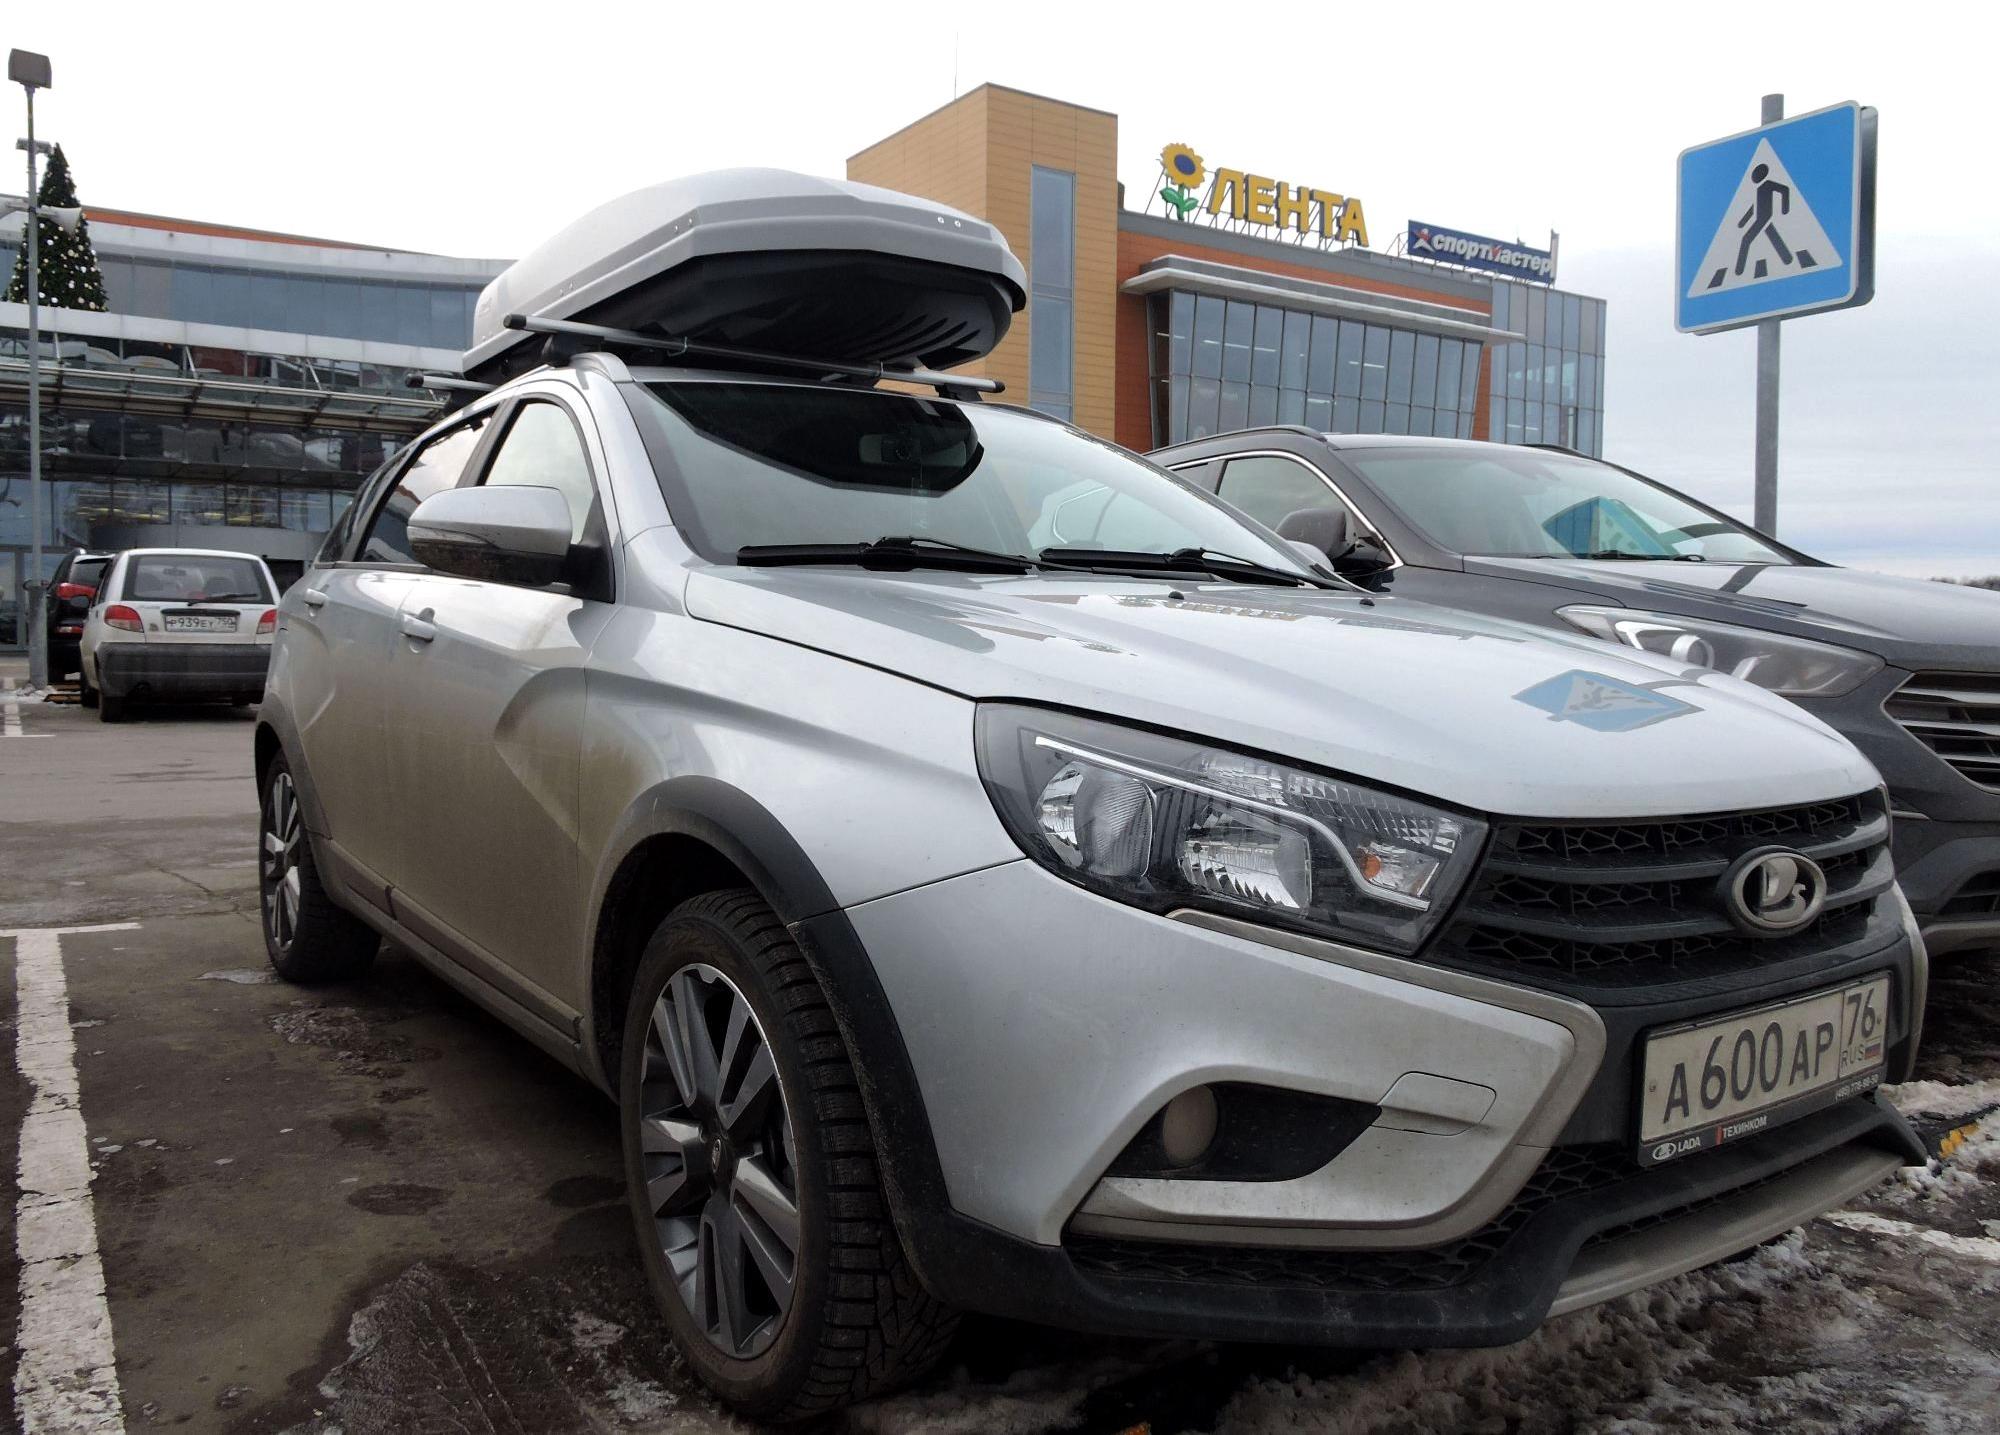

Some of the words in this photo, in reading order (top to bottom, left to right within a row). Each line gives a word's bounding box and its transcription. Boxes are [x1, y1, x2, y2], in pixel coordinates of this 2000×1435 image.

[1206, 168, 1369, 247] ЛЕНТА
[1848, 988, 1875, 1046] 76
[1841, 1043, 1864, 1067] RUS
[1678, 1137, 1701, 1152] LADA
